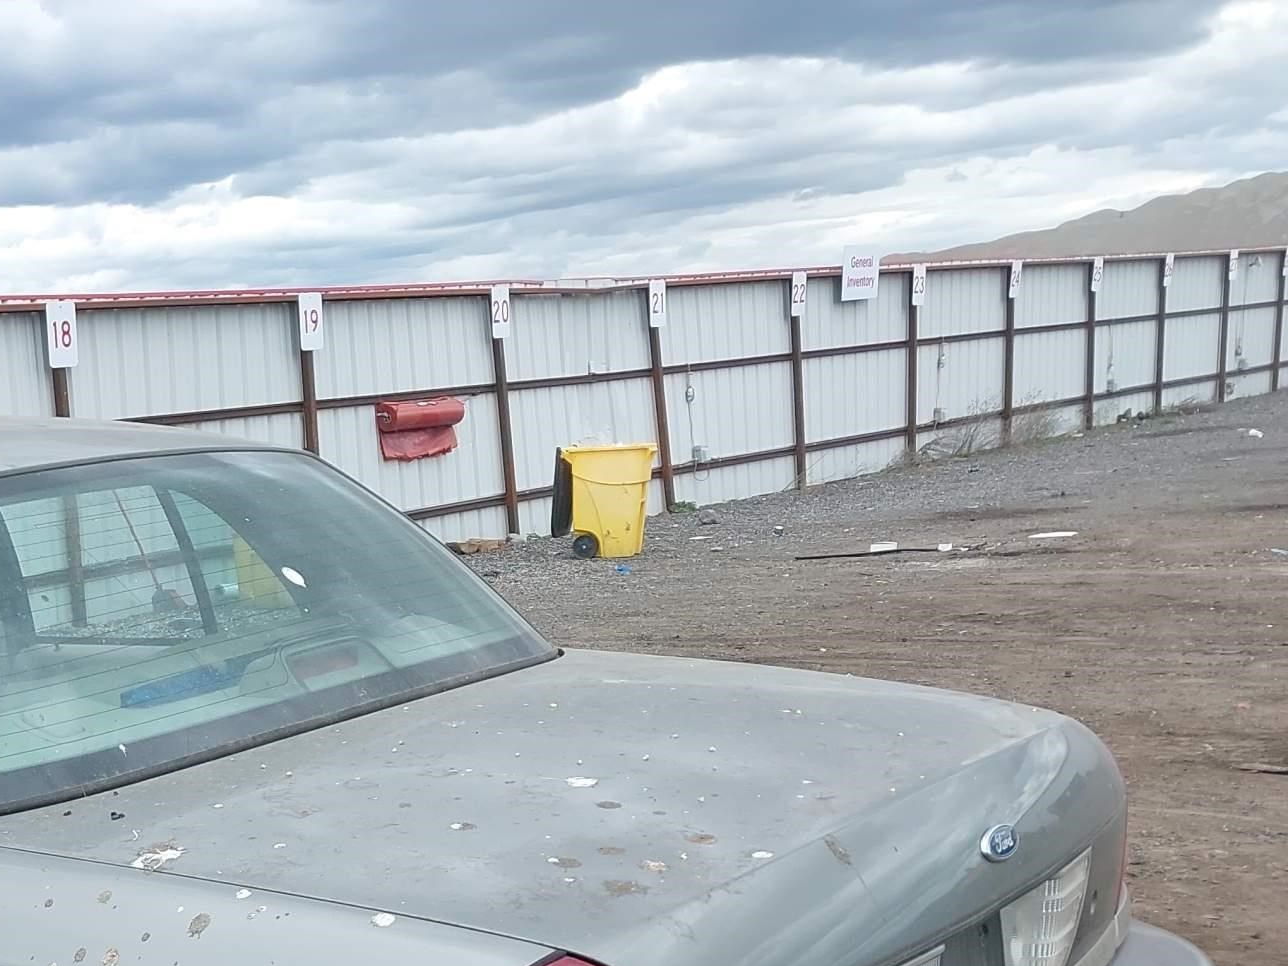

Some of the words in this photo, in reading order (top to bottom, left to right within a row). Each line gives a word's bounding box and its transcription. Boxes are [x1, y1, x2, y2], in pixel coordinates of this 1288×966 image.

[851, 256, 874, 269] General
[847, 276, 874, 288] Inventory
[914, 276, 925, 294] 23
[652, 292, 664, 314] 21
[793, 283, 806, 304] 22
[303, 309, 319, 334] 19
[493, 300, 509, 323] 20
[52, 320, 72, 349] 18
